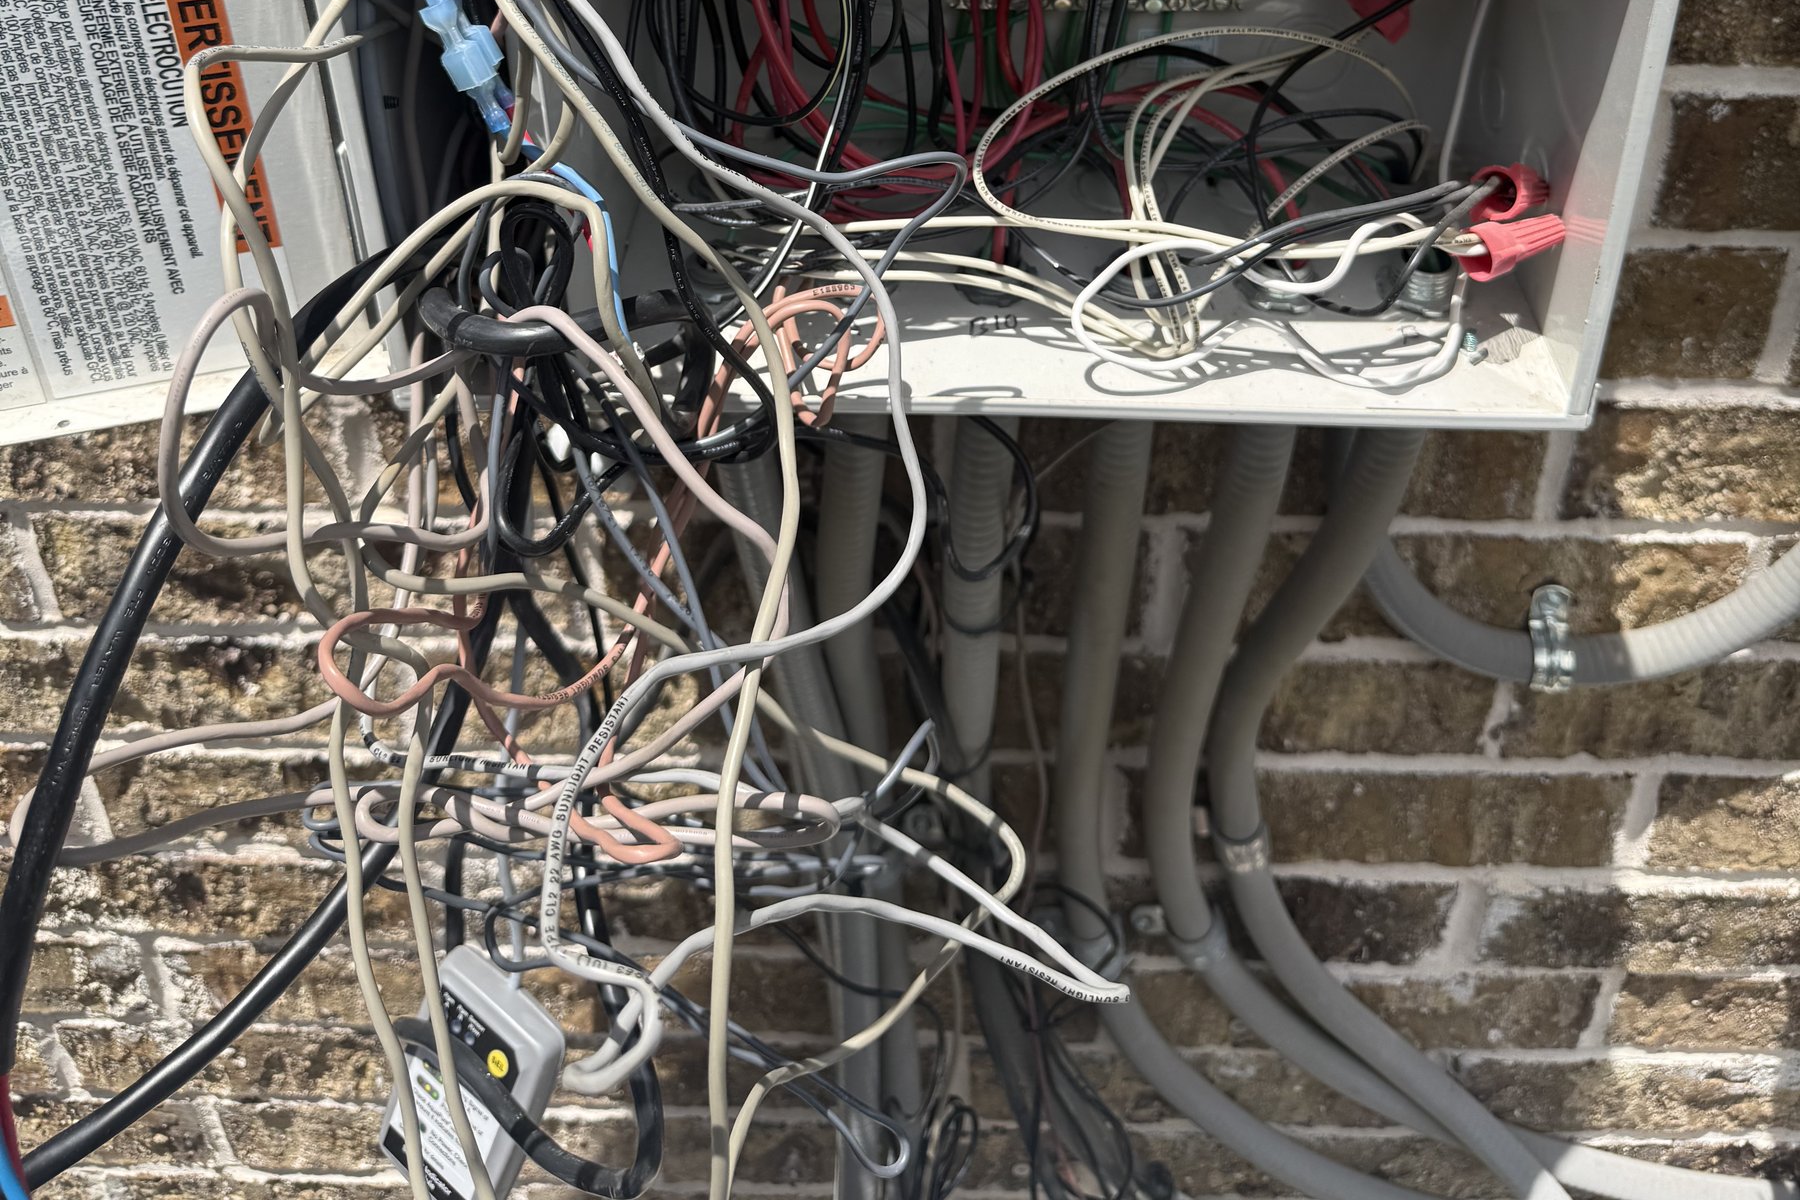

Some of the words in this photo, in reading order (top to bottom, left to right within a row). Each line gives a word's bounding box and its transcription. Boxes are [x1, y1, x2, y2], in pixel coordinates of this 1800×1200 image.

[121, 0, 138, 16] les
[83, 23, 100, 40] DE
[125, 15, 154, 76] connections
[122, 50, 135, 58] 9
[88, 41, 118, 105] COUPLAGE
[102, 49, 137, 123] EXTERIEURE,
[123, 58, 152, 116] connections
[106, 105, 122, 123] DE
[139, 76, 169, 127] électriques
[112, 123, 127, 139] LA
[125, 122, 138, 132] A
[155, 127, 172, 153] avant
[116, 140, 136, 172] SERIE
[128, 132, 153, 180] UTILISER
[163, 152, 178, 166] de
[125, 172, 152, 228] AQUALINK
[164, 165, 191, 209] dépanner
[142, 181, 178, 267] EXCLUSIVEMENT
[178, 207, 193, 223] cet
[141, 228, 157, 244] RS
[179, 222, 204, 259] appareil.
[166, 267, 185, 295] AVEC
[589, 695, 629, 754] RESISTANT
[556, 756, 590, 825] SUNLIGHT
[549, 829, 563, 864] AWG
[549, 867, 561, 886] 22
[545, 890, 558, 917] CL2
[1063, 985, 1120, 1003] SUNLIGHT
